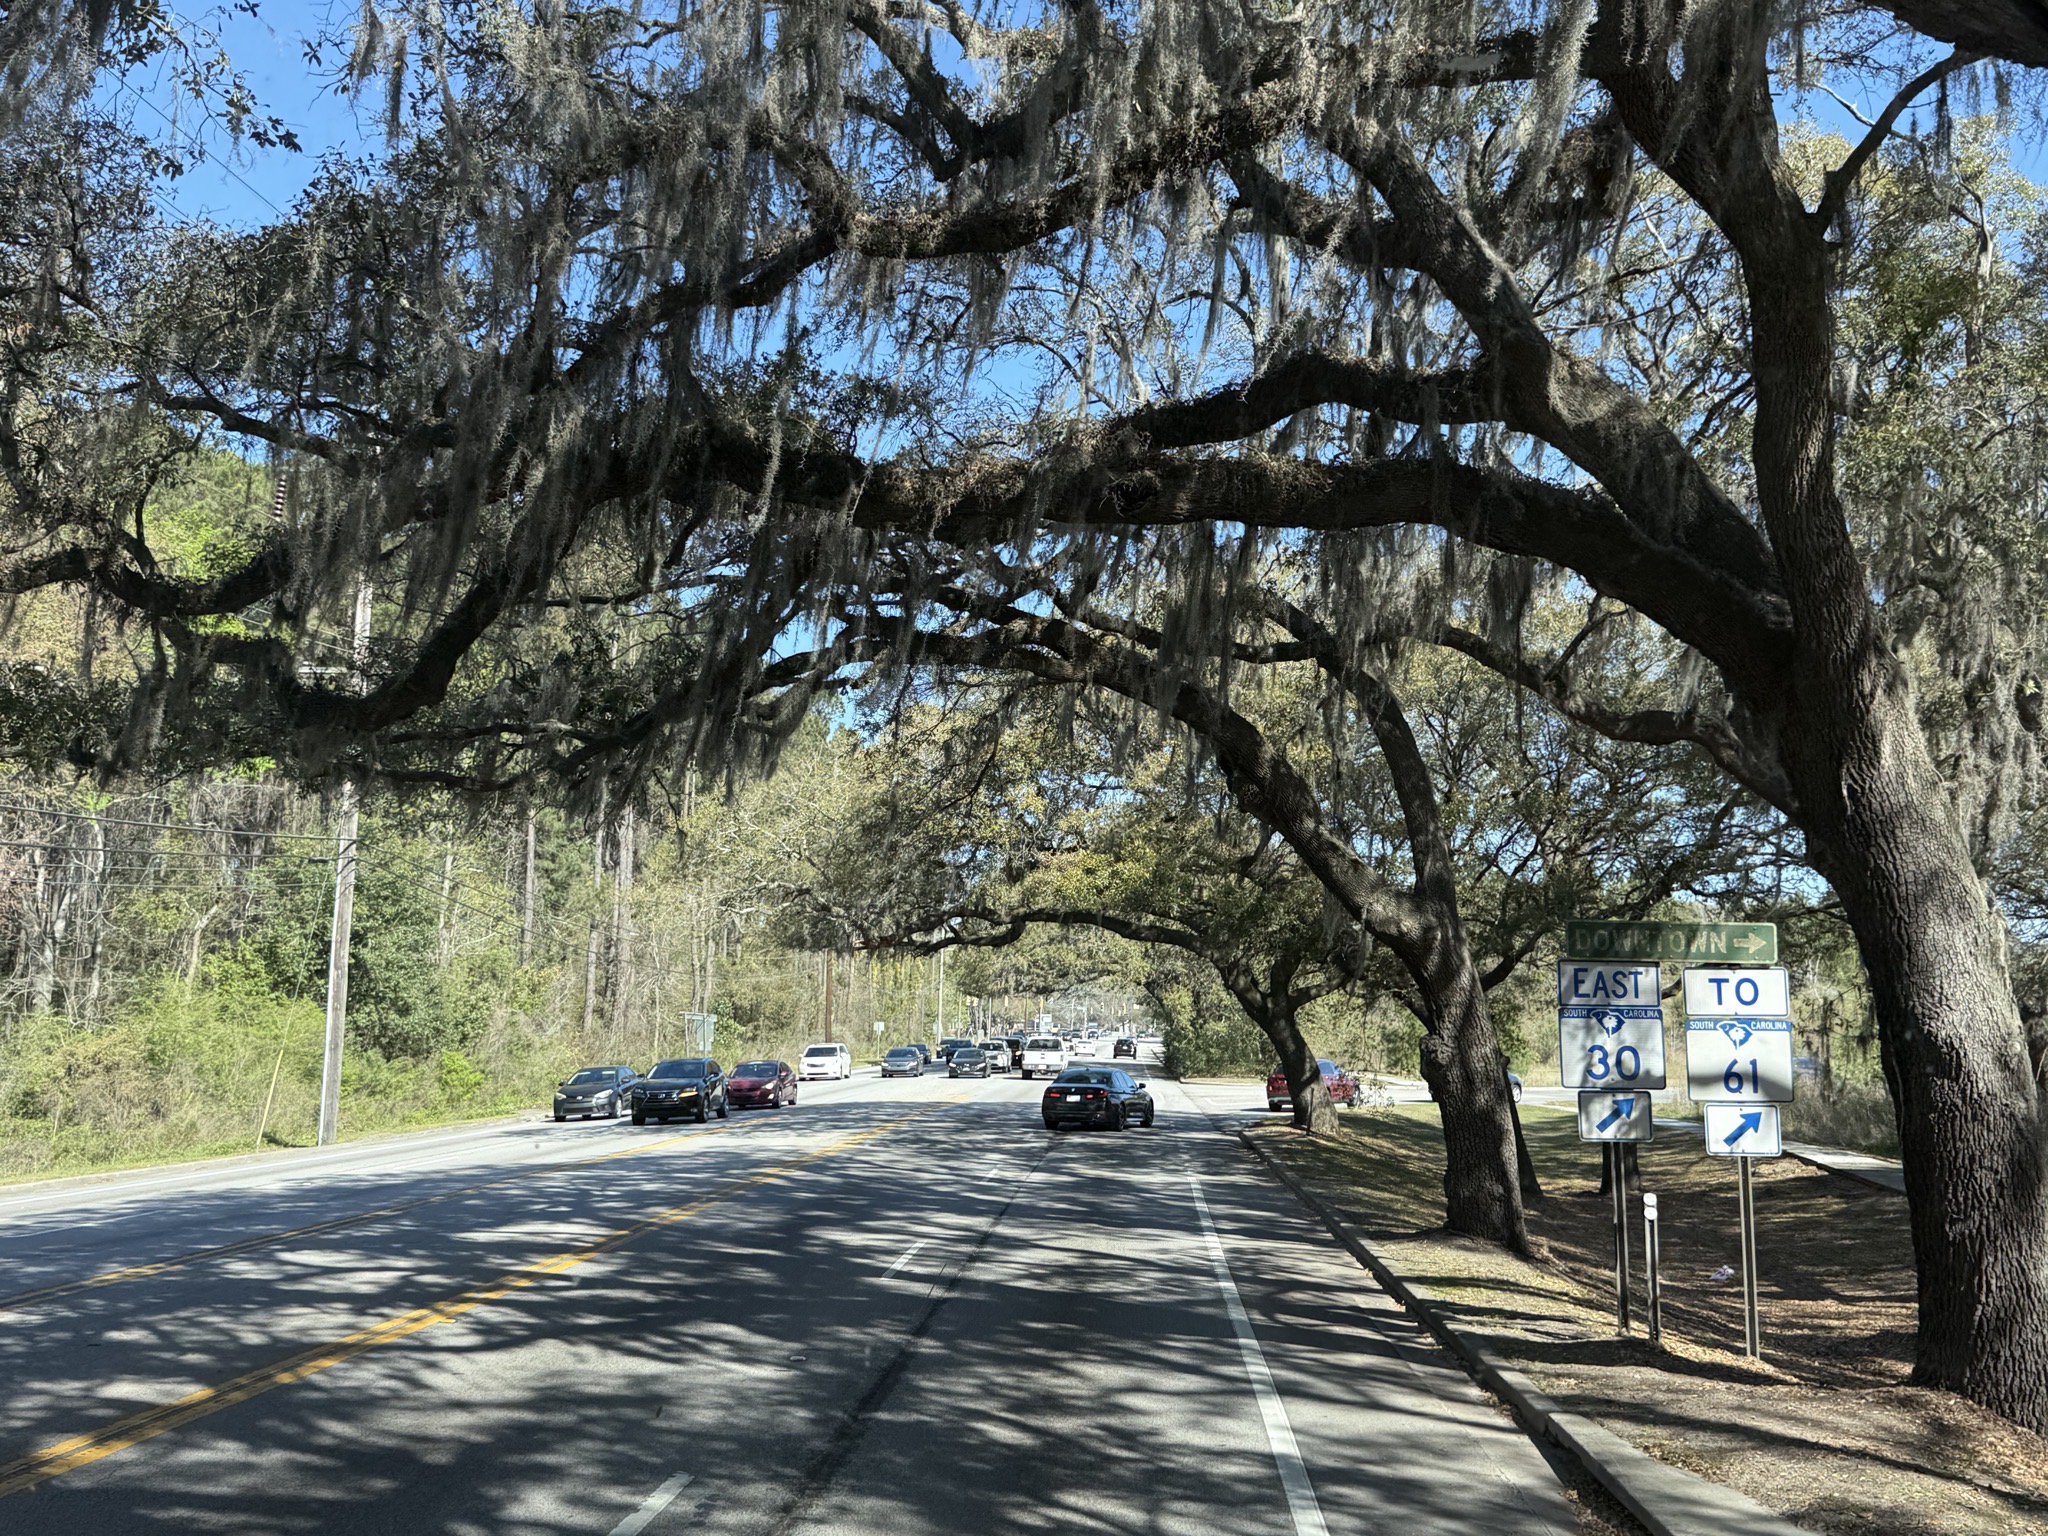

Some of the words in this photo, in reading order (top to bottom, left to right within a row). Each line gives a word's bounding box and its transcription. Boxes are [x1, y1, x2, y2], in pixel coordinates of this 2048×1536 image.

[1575, 928, 1727, 954] DOWNTOWN
[1573, 967, 1643, 999] EAST
[1708, 977, 1759, 1006] TO
[1563, 1008, 1588, 1018] SOUTH
[1623, 1009, 1660, 1019] CAROLINA
[1689, 1020, 1714, 1030] SOUTH
[1750, 1021, 1787, 1030] CAROLINA
[1586, 1044, 1641, 1082] 30
[1723, 1058, 1759, 1094] 61
